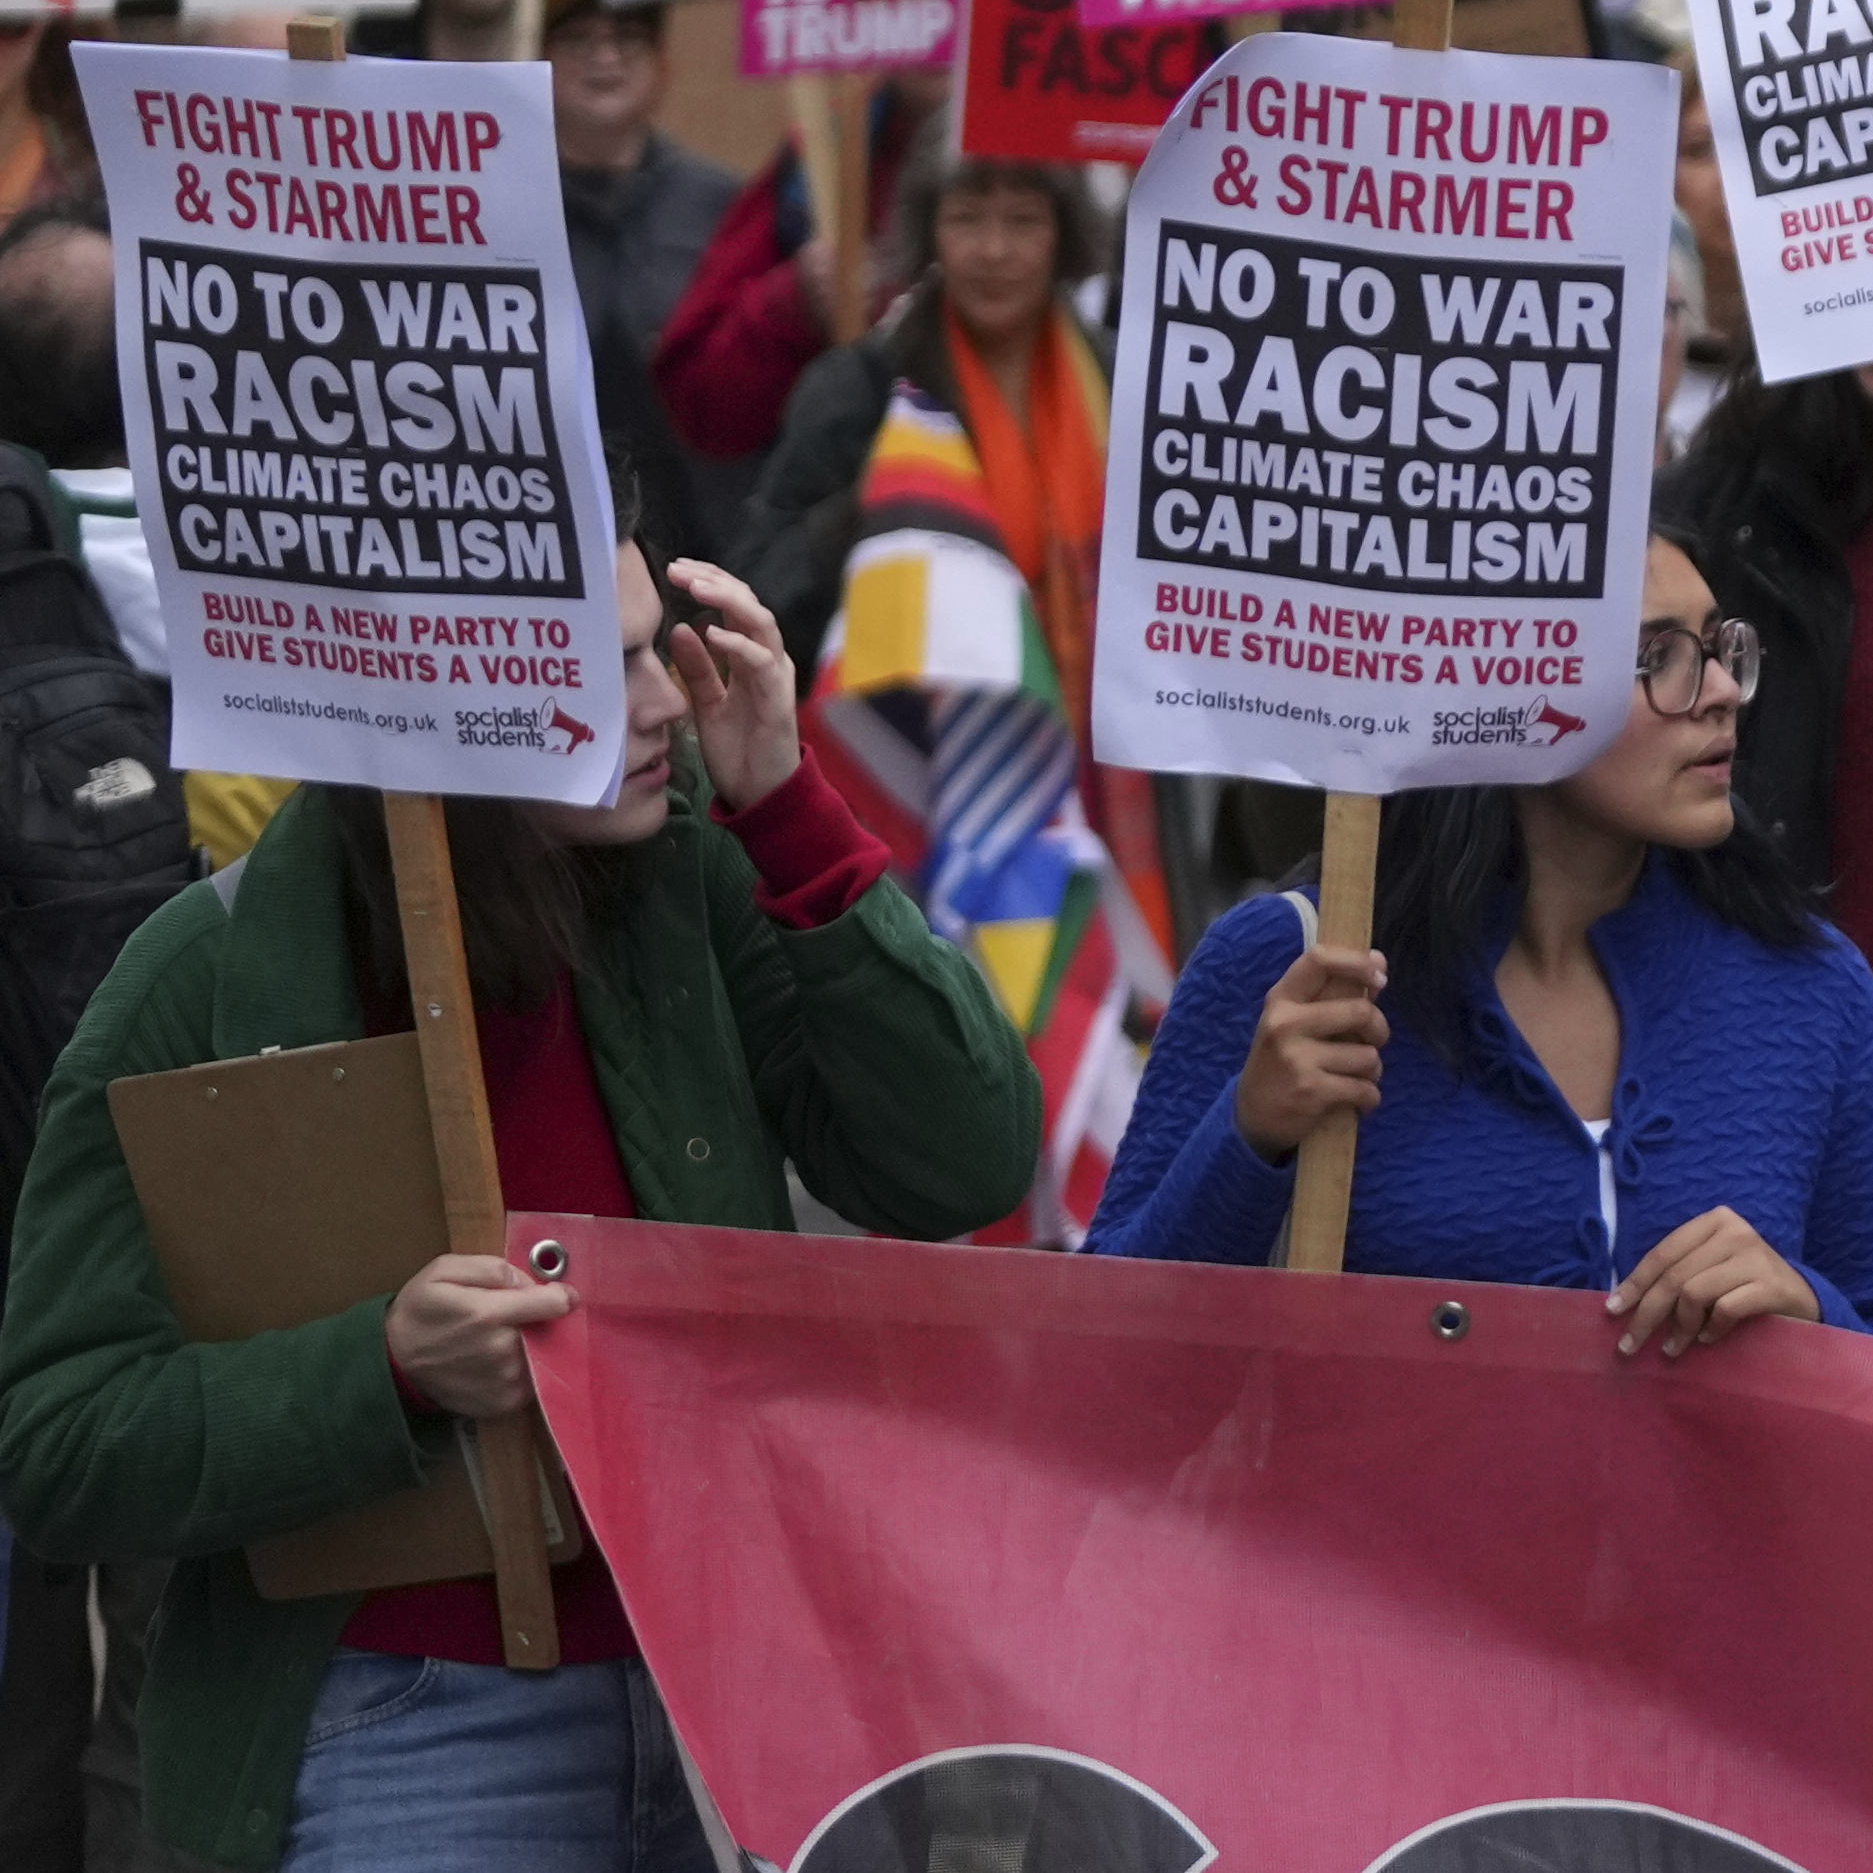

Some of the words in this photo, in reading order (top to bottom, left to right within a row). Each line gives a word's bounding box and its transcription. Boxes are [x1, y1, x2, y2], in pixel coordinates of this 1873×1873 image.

[136, 92, 281, 161] FIGHT
[293, 107, 499, 172] TRUMP
[1191, 77, 1367, 149] FIGHT
[1380, 97, 1609, 166] TRUMP
[176, 163, 214, 224] &
[227, 169, 485, 245] STARMER
[1213, 146, 1257, 209] &
[1278, 156, 1574, 240] STARMER
[147, 257, 238, 334] NO
[254, 271, 344, 345] TO
[361, 281, 539, 353] WAR
[1163, 239, 1275, 318] NO
[1299, 258, 1395, 336] TO
[1421, 274, 1614, 350] WAR
[155, 340, 546, 457] RACISM
[1159, 321, 1602, 454] RACISM
[167, 444, 369, 506] CLIMATE
[380, 462, 554, 512] CHAOS
[180, 504, 565, 581] CAPITALISM
[203, 593, 295, 628] BUILD
[306, 606, 325, 632] A
[332, 609, 397, 641] NEW
[411, 617, 518, 646] PARTY
[530, 620, 570, 649] TO
[203, 629, 276, 663] GIVE
[284, 638, 438, 682] STUDENTS
[450, 656, 470, 683] A
[480, 657, 582, 687] VOICE
[224, 694, 438, 734] socialiststudents.org.uk
[454, 705, 540, 731] socialist
[457, 726, 546, 750] students
